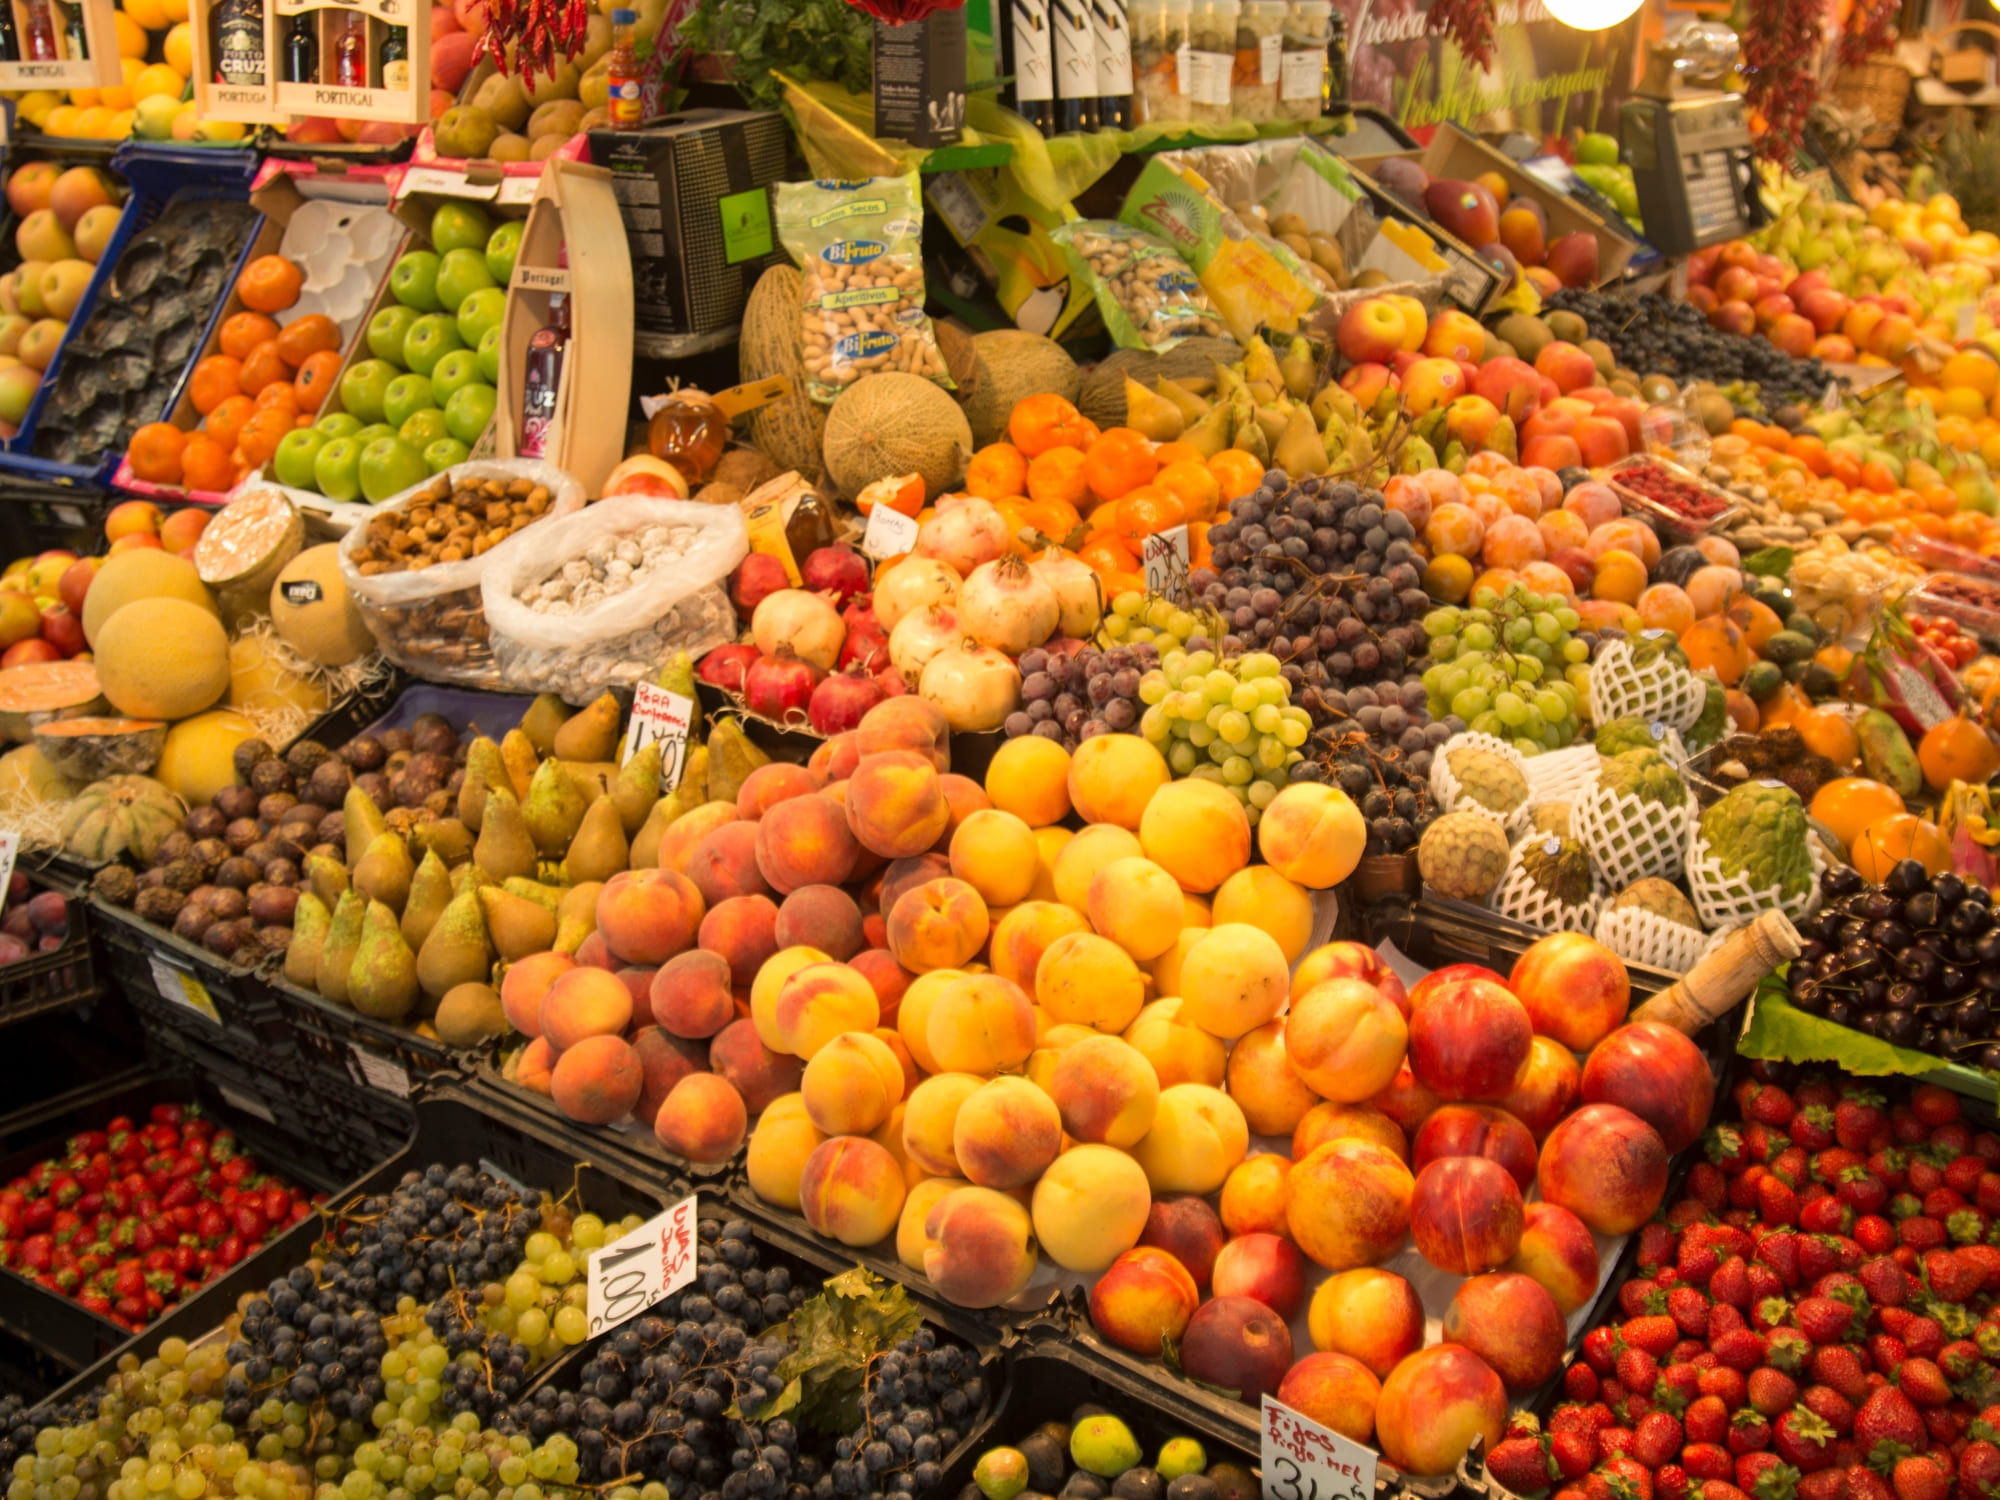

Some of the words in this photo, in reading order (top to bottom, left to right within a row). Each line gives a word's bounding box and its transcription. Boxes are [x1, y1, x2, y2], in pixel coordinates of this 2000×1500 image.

[220, 59, 265, 74] CRUZ
[218, 90, 267, 103] PORTUGA
[315, 90, 374, 108] PORTUGAL
[850, 202, 881, 213] Secos
[1140, 194, 1204, 249] Zespri
[828, 241, 883, 263] BiFruta
[521, 270, 565, 286] Portugal
[834, 291, 887, 306] Aperitivos
[842, 332, 895, 356] BiFruta
[673, 1204, 691, 1275] UVAS
